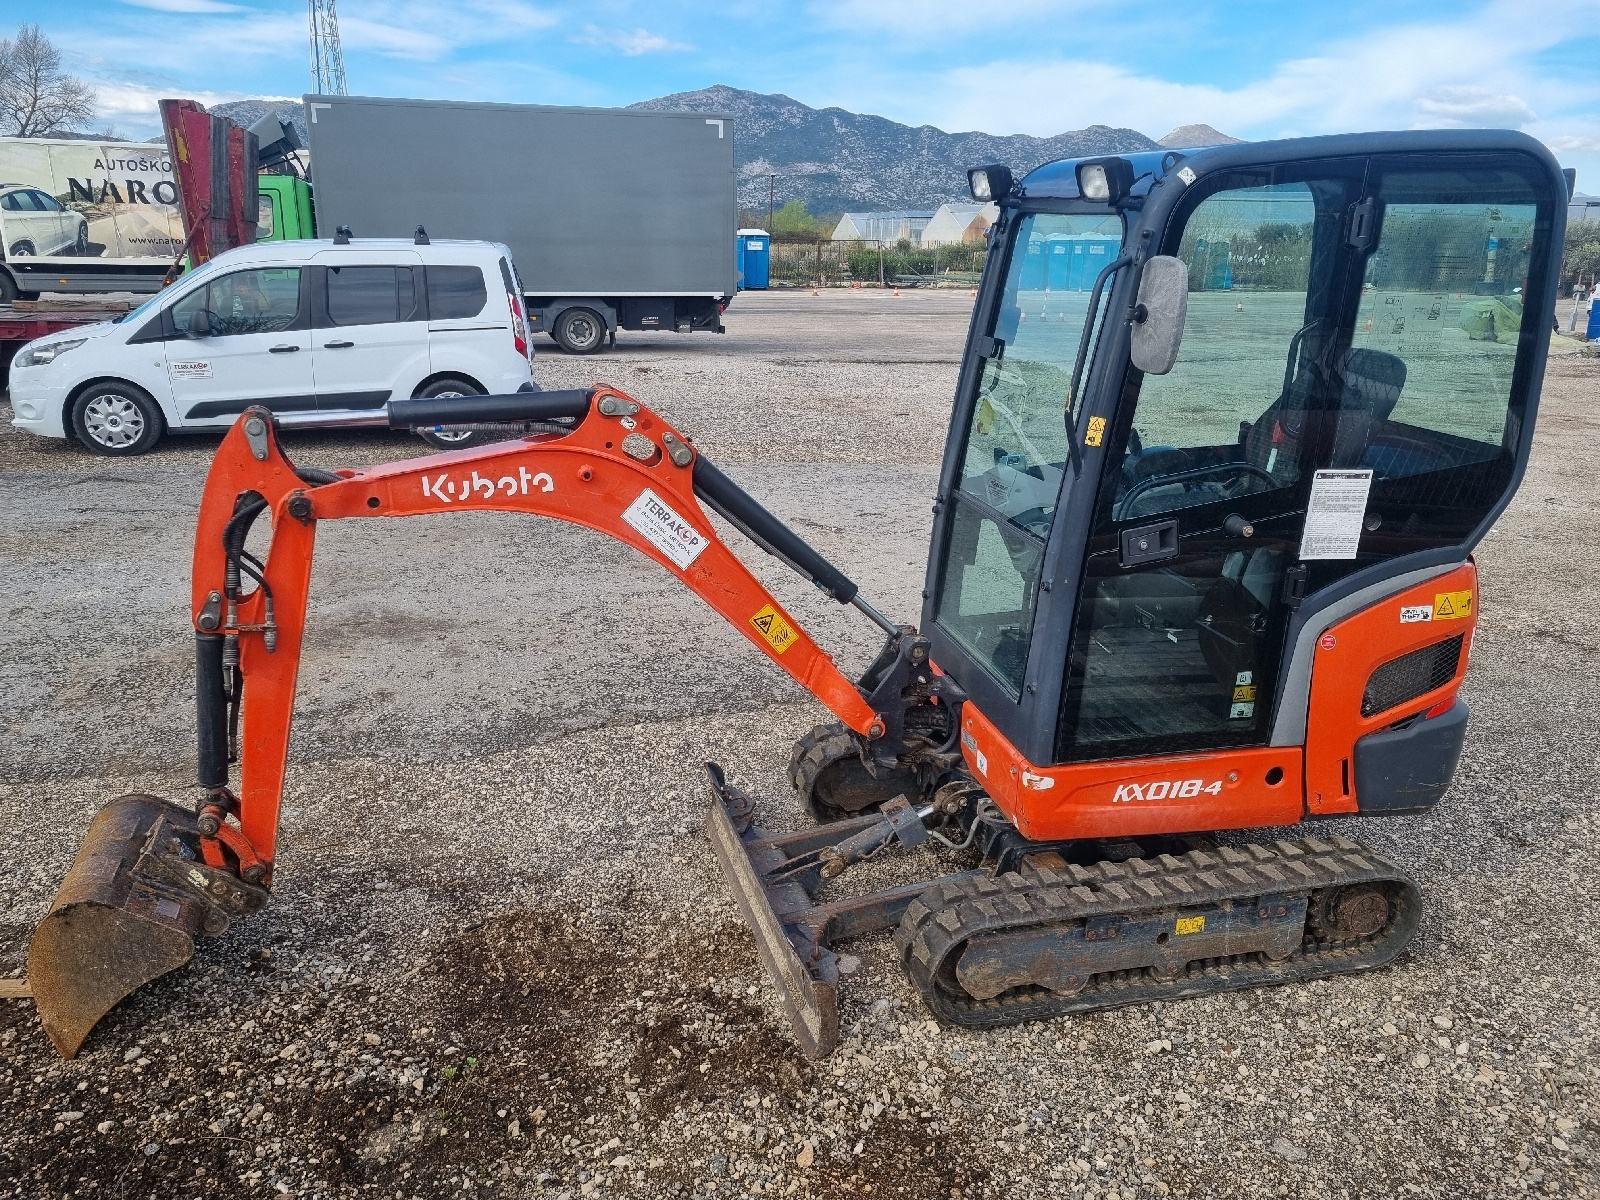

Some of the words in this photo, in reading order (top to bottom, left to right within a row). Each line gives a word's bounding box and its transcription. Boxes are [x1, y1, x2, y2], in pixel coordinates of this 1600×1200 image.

[421, 466, 555, 503] Kubota
[644, 496, 699, 546] TERRAKOP
[1112, 779, 1223, 803] KX018-4
